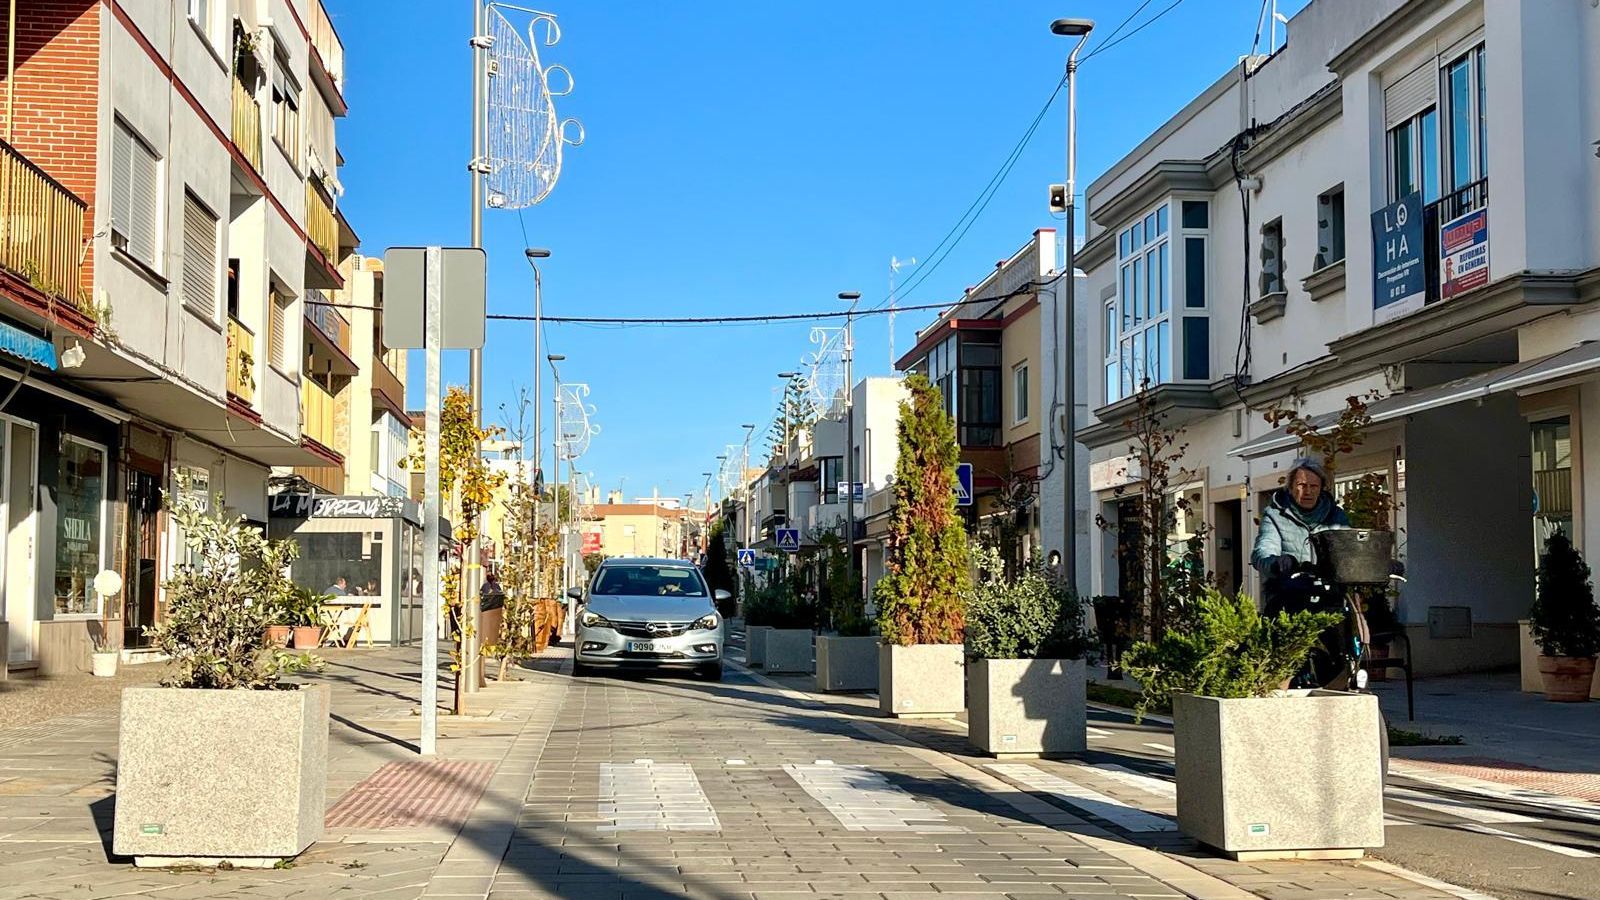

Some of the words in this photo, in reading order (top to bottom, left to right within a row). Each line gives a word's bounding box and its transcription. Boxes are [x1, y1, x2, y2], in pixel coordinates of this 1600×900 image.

[1459, 245, 1486, 264] REFORMAS
[1458, 264, 1465, 274] EN
[1465, 255, 1486, 272] GENERAL
[272, 494, 291, 512] LA
[64, 517, 92, 542] SHEILA
[633, 642, 654, 651] 9090
